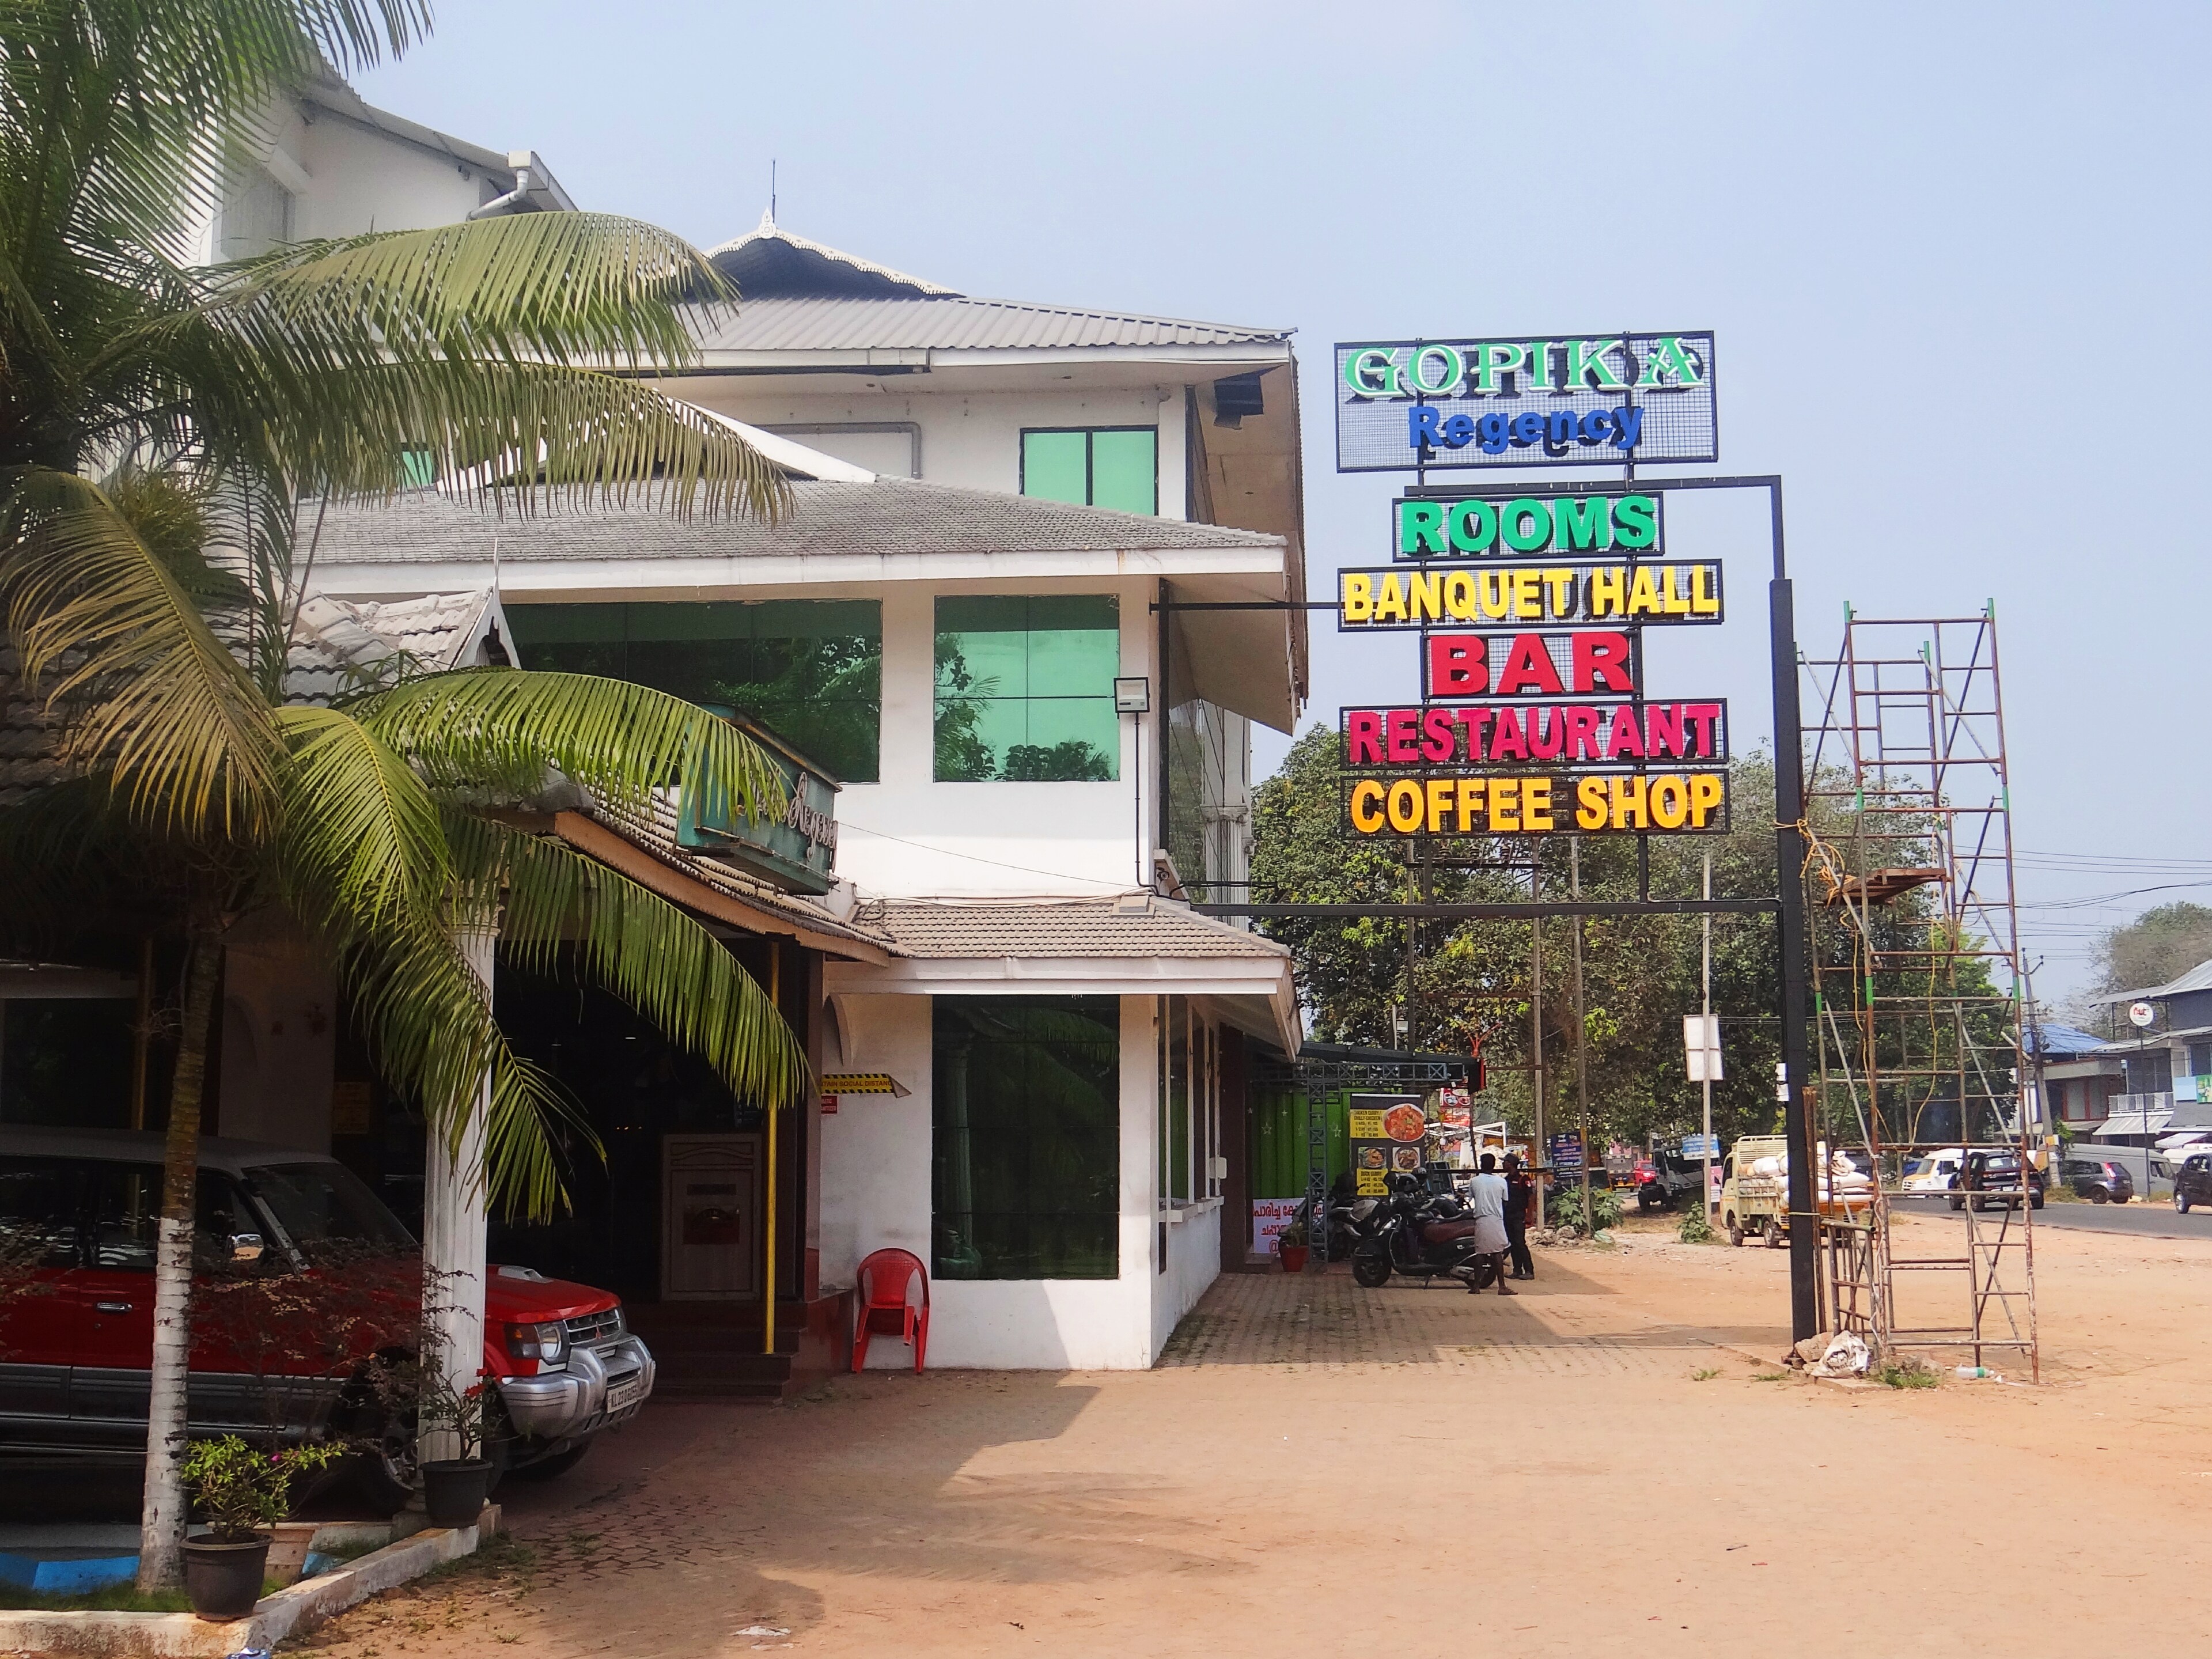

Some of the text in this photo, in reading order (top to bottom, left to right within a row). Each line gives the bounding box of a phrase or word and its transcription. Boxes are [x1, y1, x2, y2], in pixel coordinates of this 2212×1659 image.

[1345, 337, 1706, 397] GOPIKA
[1408, 406, 1644, 455] Regency
[1402, 495, 1656, 553] ROOMS
[1344, 565, 1719, 622] BANQUET HALL
[1430, 631, 1634, 695] BAR
[1349, 704, 1719, 763] RESTAURANT
[1351, 774, 1722, 833] COFFEE SHOP
